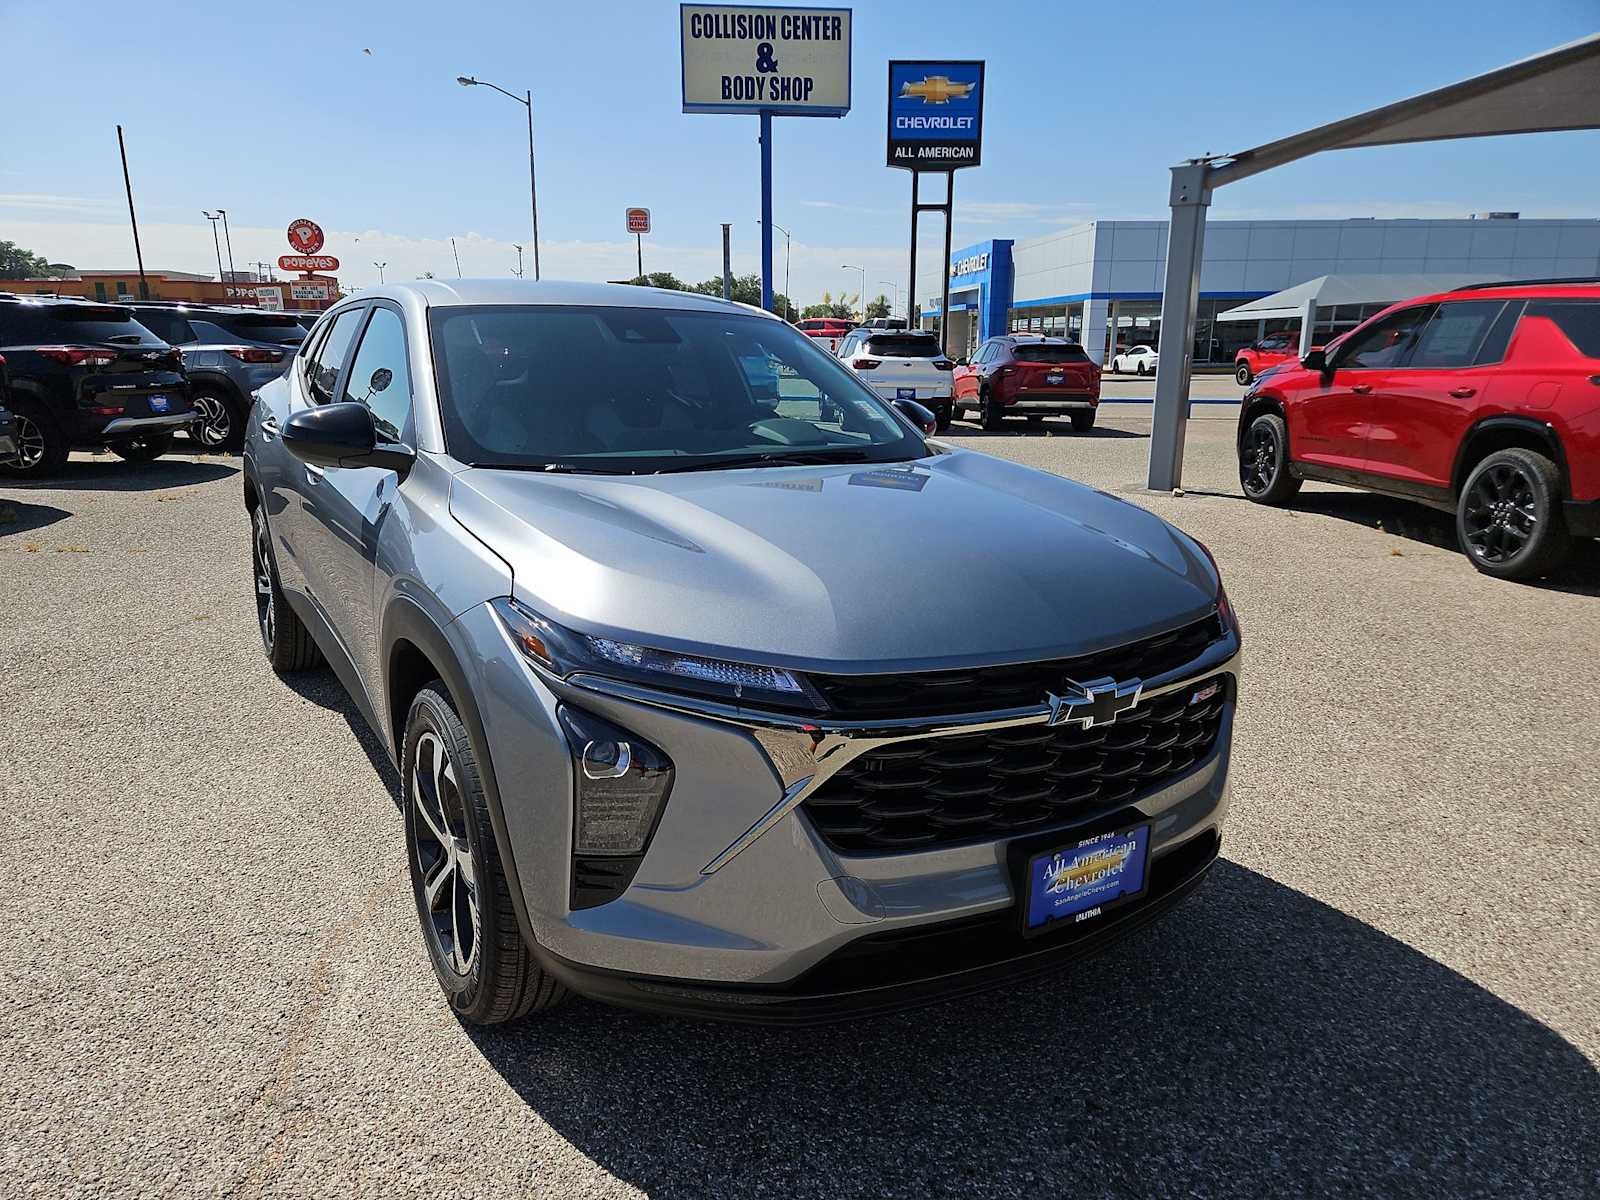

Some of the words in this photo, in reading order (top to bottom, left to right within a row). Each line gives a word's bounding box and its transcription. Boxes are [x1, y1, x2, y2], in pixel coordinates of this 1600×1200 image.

[690, 13, 777, 40] COLLISION
[781, 14, 842, 41] CENTER
[755, 42, 778, 73] &
[721, 75, 766, 101] BODY
[769, 76, 814, 101] SHOP
[896, 116, 974, 129] CHEVROLET
[894, 147, 915, 158] ALL
[917, 147, 974, 159] AMERICAN
[1078, 835, 1100, 849] SINCE
[1043, 858, 1066, 881] All
[1071, 840, 1137, 869] American
[1054, 861, 1125, 894] Chevrolet
